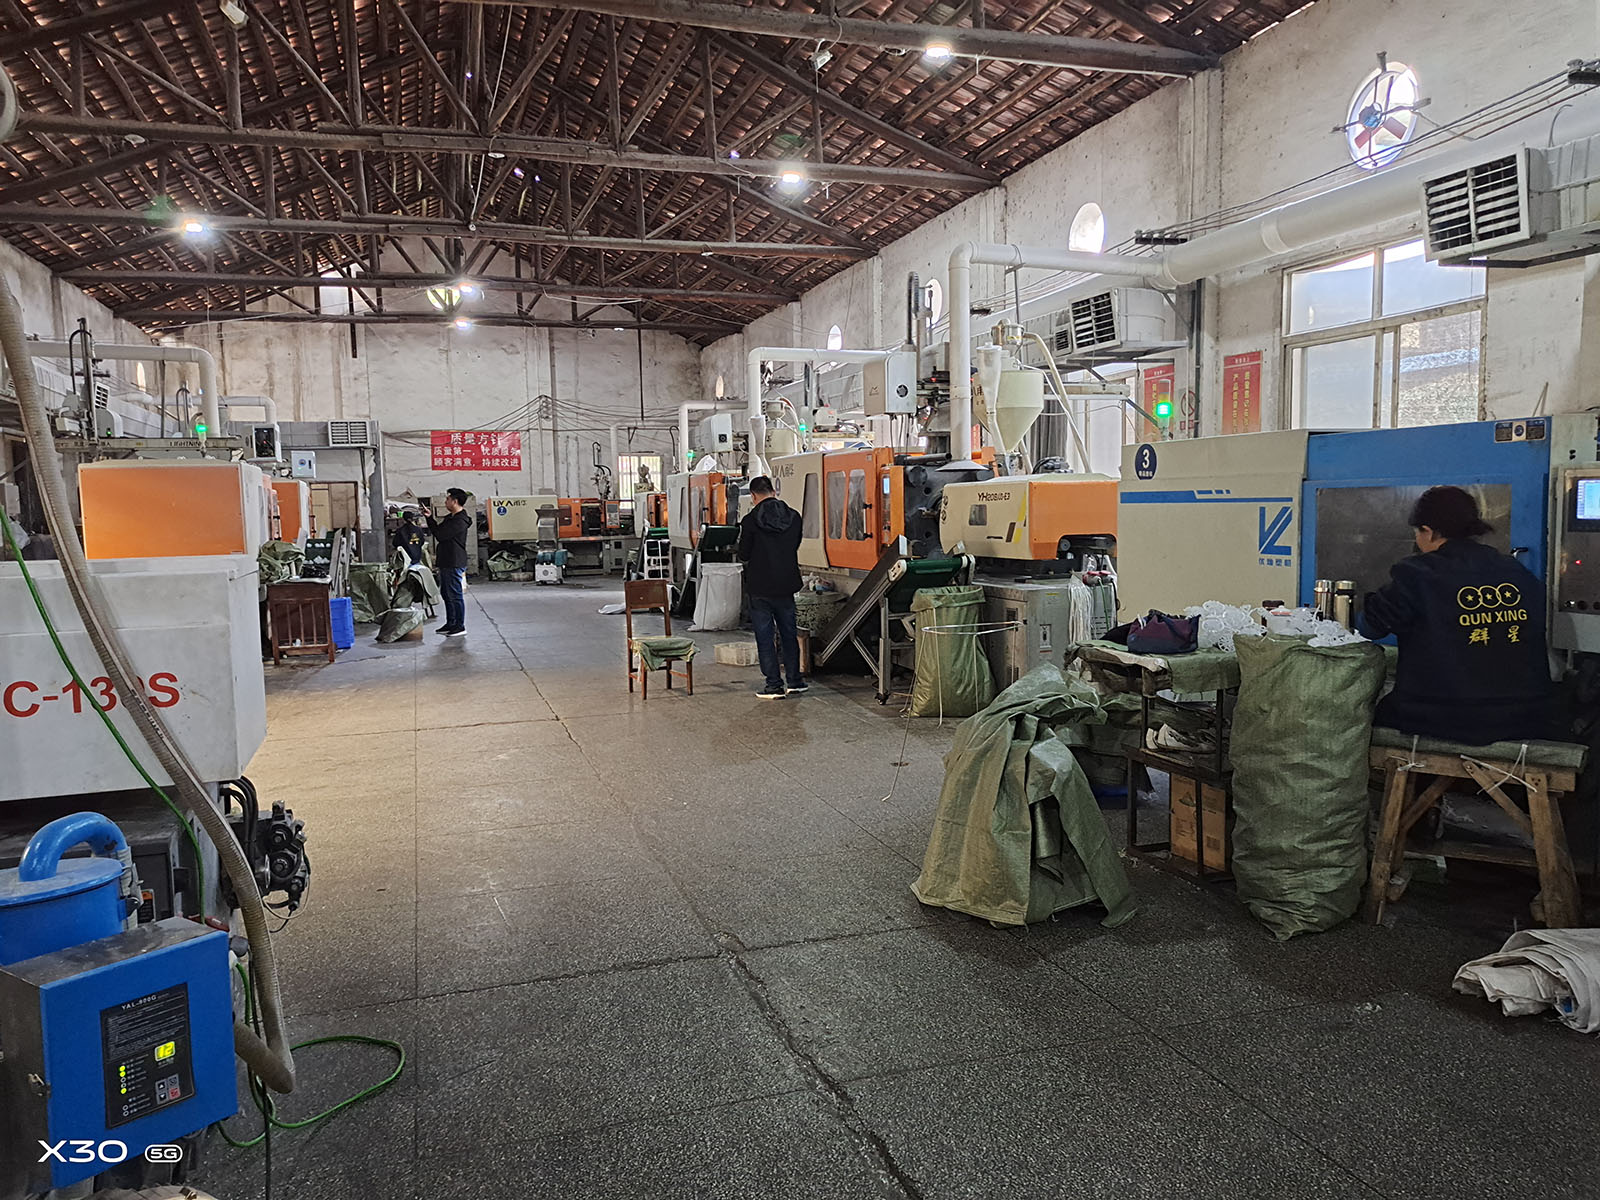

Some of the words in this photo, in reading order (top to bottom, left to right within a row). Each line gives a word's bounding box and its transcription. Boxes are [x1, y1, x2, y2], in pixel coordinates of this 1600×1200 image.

[451, 432, 501, 446] 质量方针
[1142, 448, 1150, 469] 3
[1460, 612, 1493, 626] QUN
[1495, 608, 1527, 623] XING
[3, 672, 180, 718] C-13S
